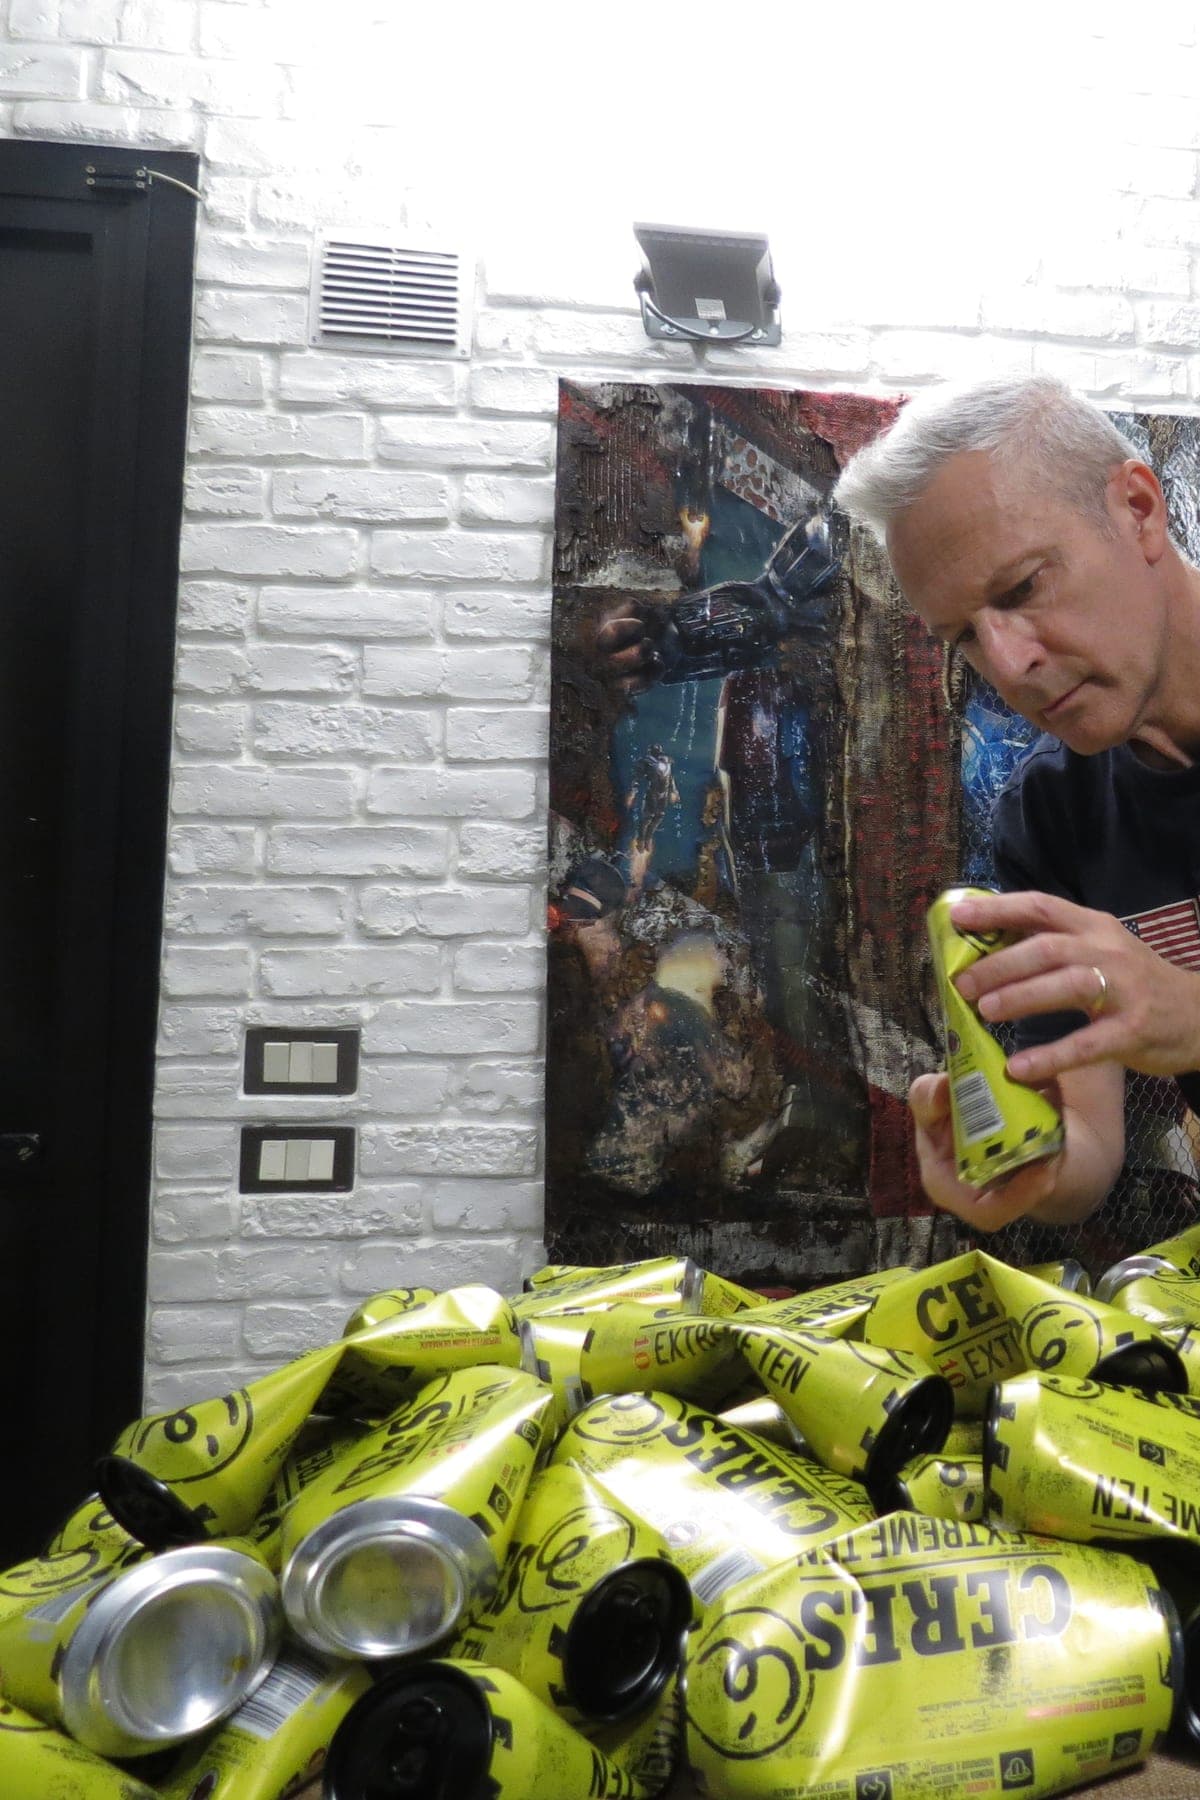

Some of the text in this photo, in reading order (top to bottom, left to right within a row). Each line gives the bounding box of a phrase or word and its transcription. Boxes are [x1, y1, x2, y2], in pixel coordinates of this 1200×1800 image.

[757, 1338, 812, 1395] TEN
[660, 1414, 840, 1536] CERES
[1091, 1474, 1154, 1527] TEN
[800, 1564, 1072, 1672] CERES
